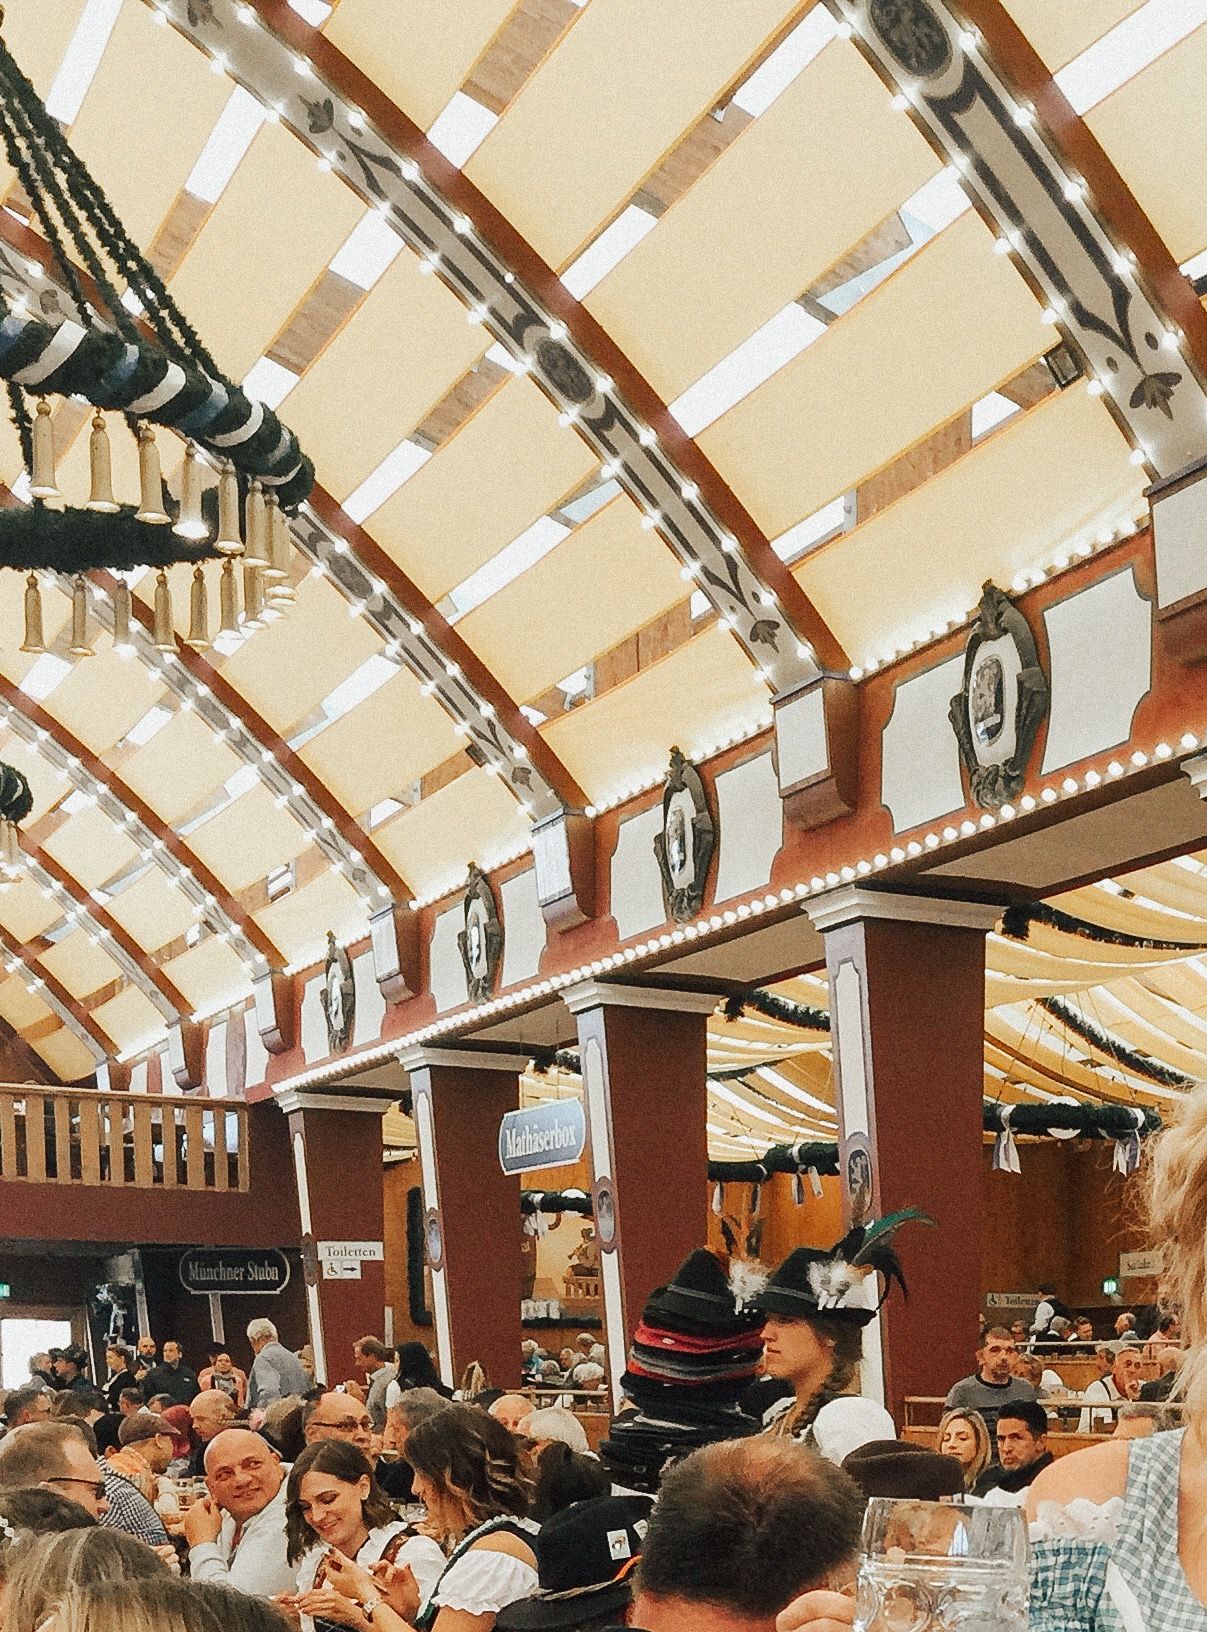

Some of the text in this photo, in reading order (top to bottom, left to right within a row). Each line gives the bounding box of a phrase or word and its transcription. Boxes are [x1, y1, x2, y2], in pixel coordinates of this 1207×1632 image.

[505, 1118, 577, 1159] Mathäserbox
[325, 1245, 377, 1257] Toiletten
[189, 1260, 279, 1281] Münchner Stubn
